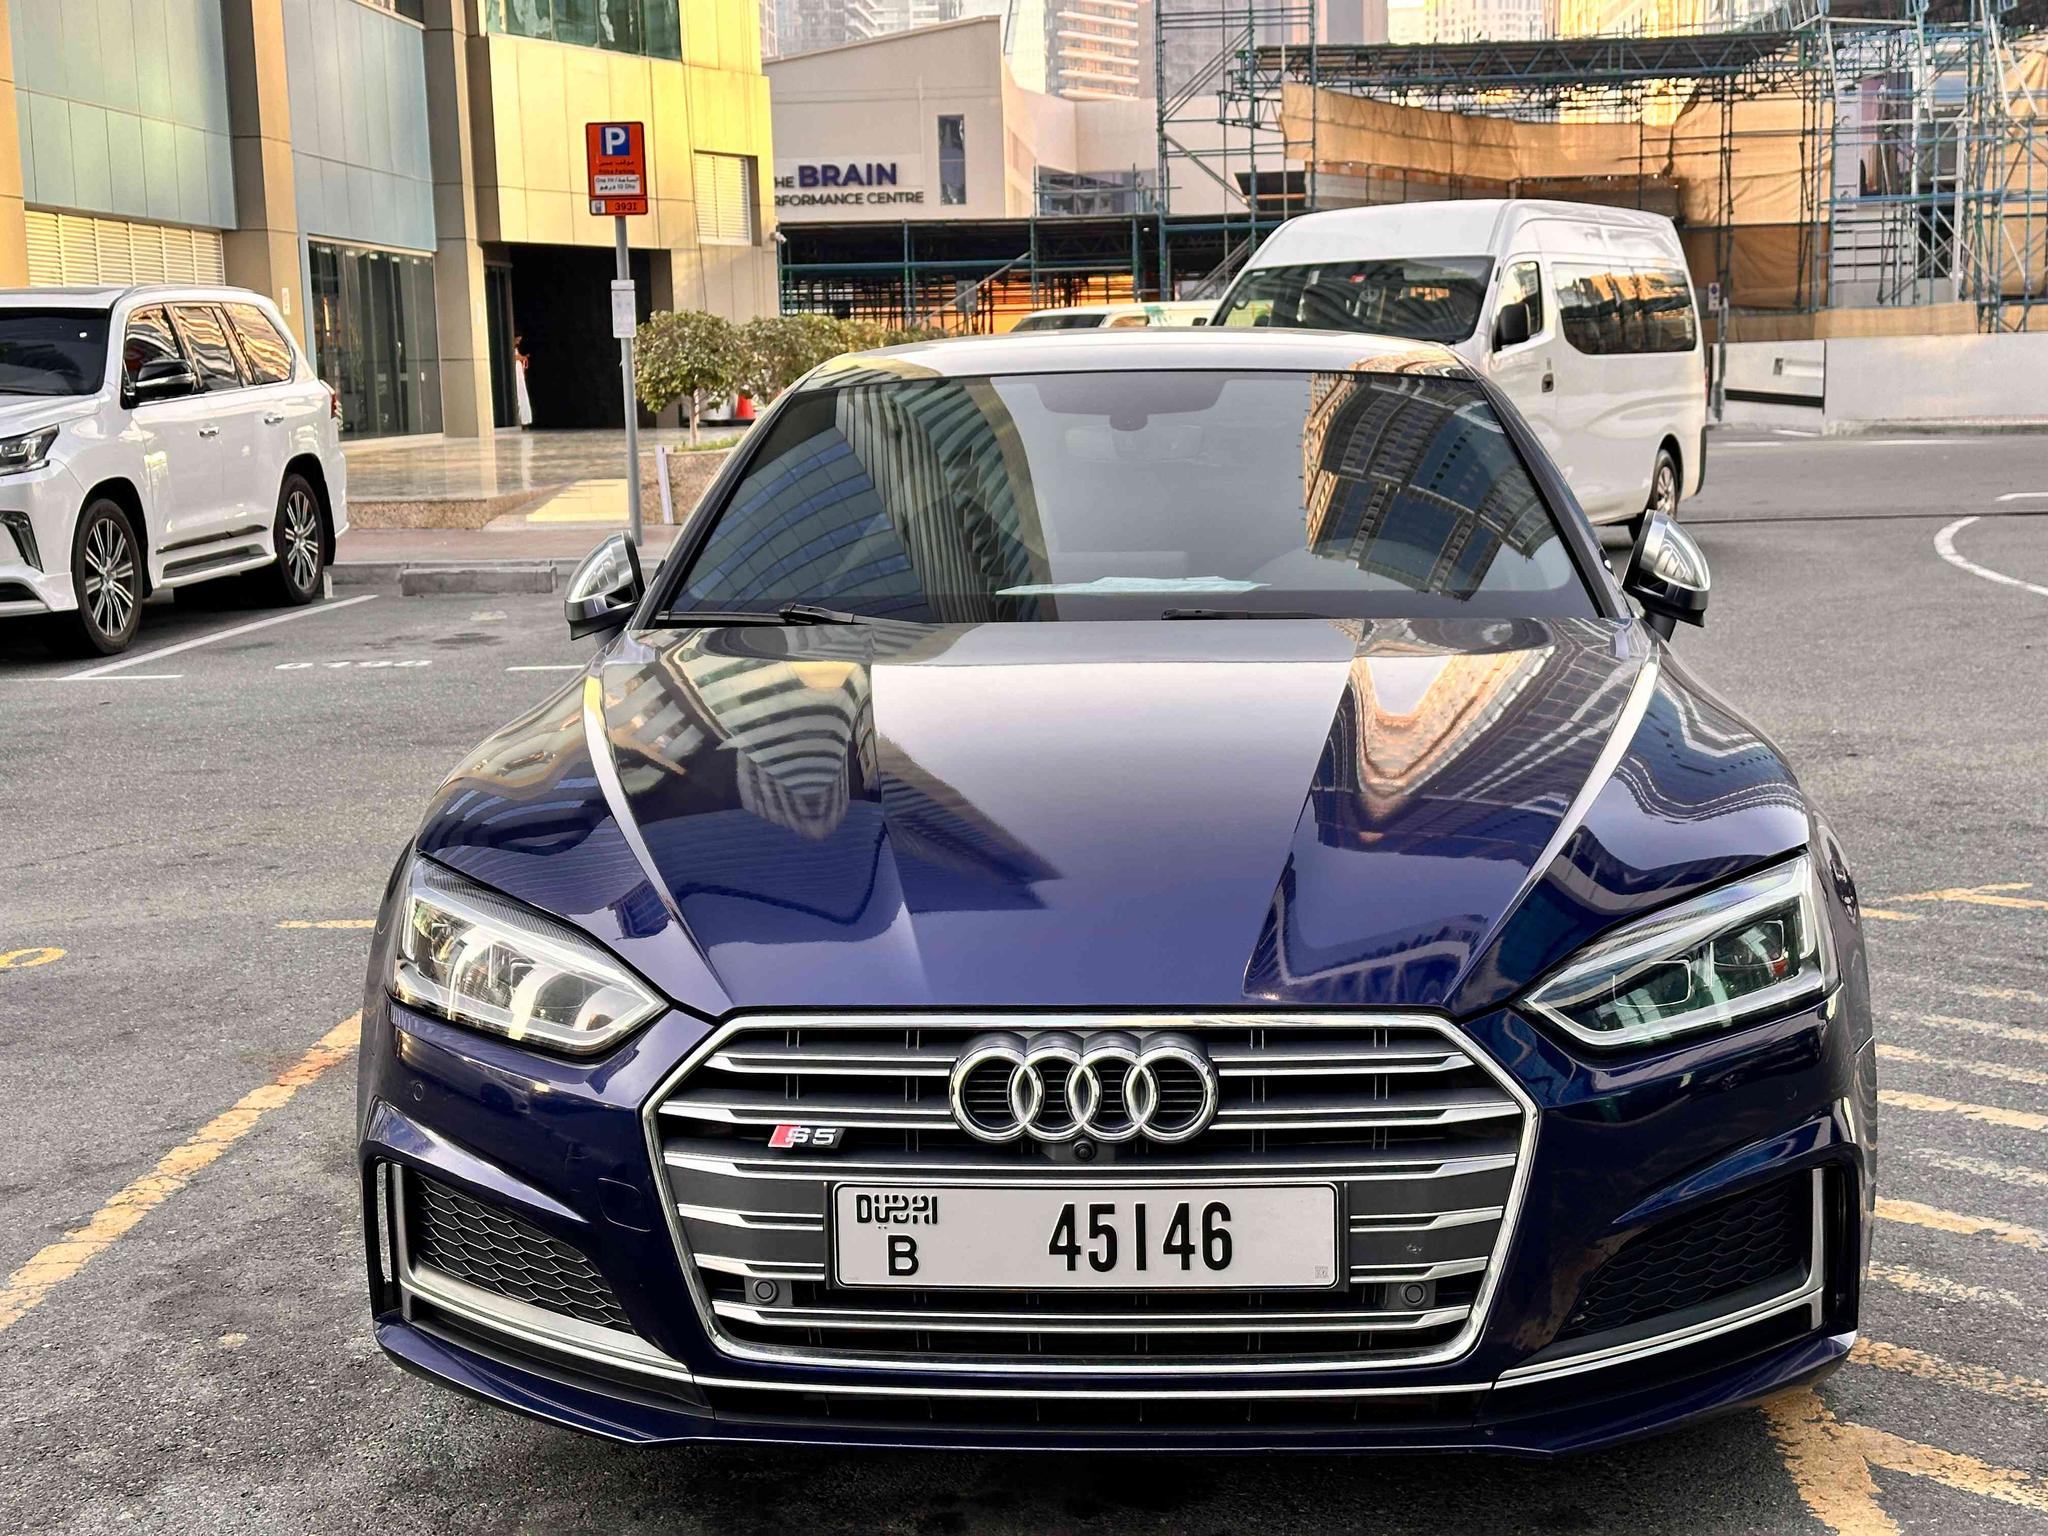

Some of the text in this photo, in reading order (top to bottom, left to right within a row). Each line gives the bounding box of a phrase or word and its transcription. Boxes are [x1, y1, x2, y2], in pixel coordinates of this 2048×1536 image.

[604, 127, 626, 155] P
[798, 163, 897, 187] BRAIN
[867, 191, 924, 204] CENTRE
[784, 1127, 836, 1145] S5
[1048, 1201, 1233, 1272] 45146
[887, 1234, 920, 1276] B
